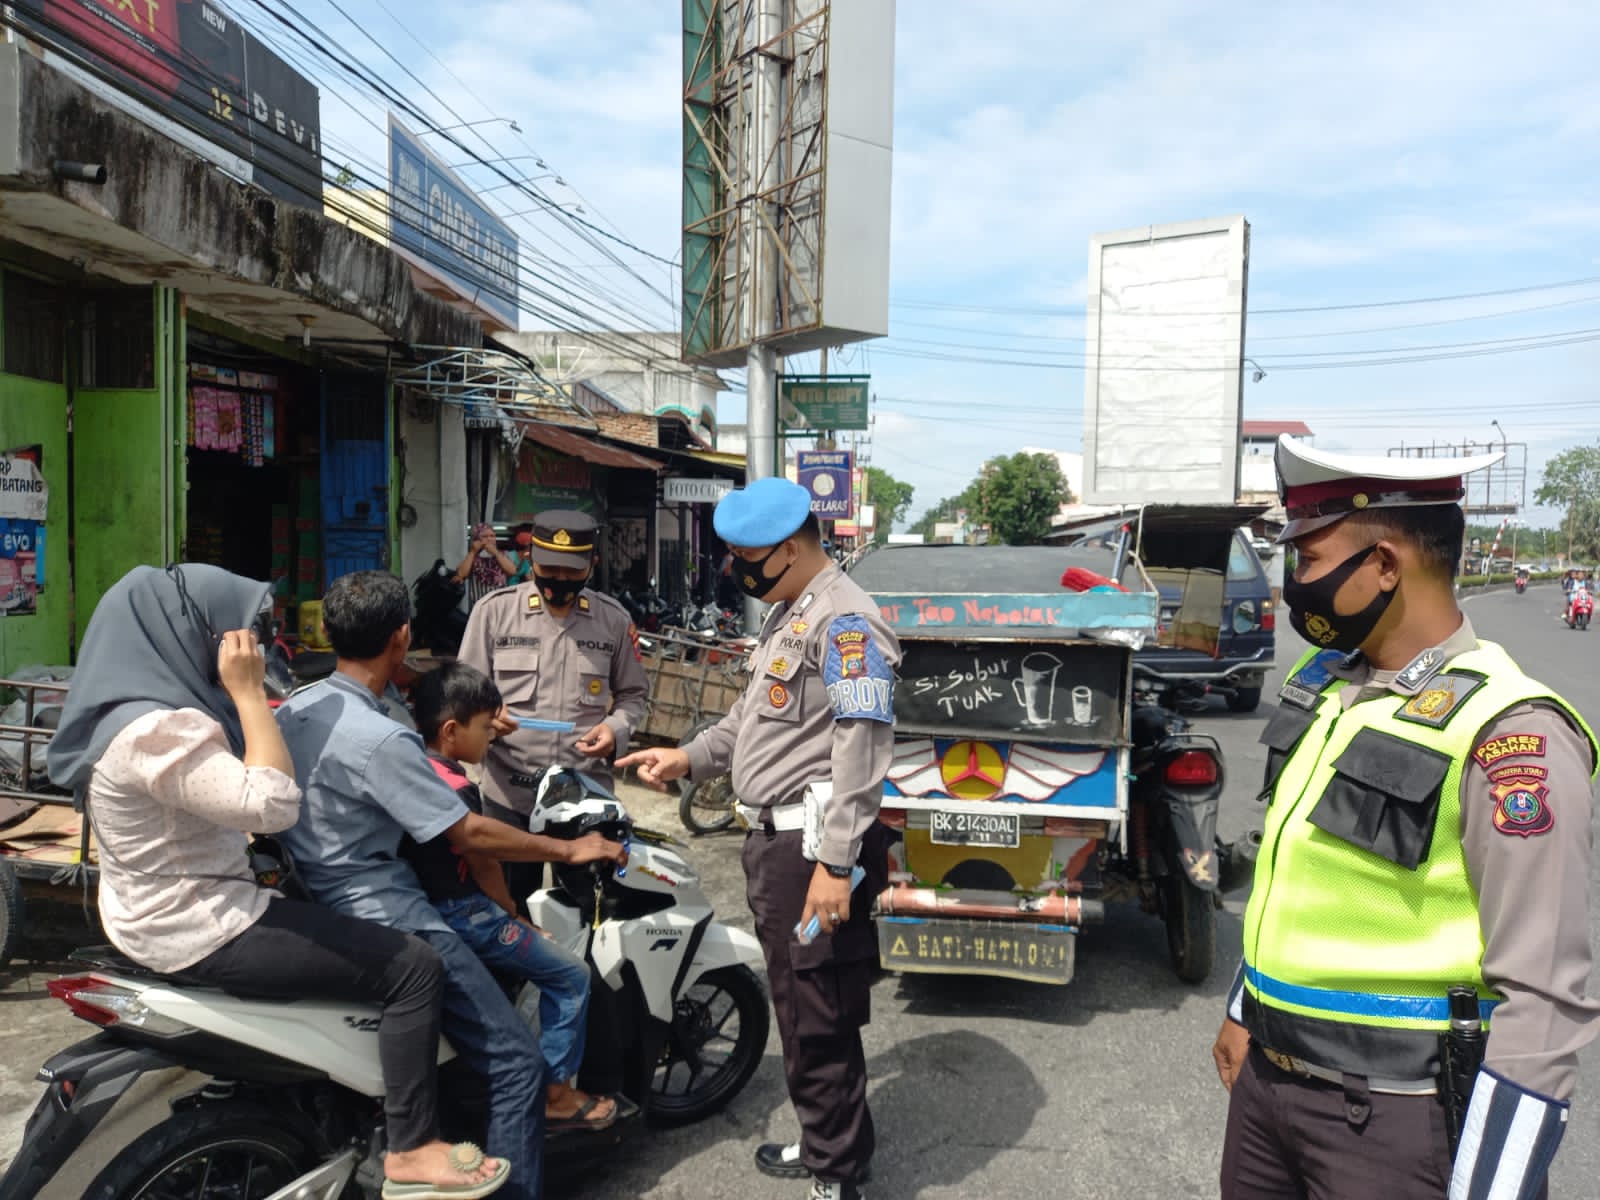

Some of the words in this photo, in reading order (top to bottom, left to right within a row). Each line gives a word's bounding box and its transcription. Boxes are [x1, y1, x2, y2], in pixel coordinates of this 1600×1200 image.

[201, 3, 227, 33] NEW
[669, 483, 698, 497] FOTO
[577, 639, 613, 652] POLRI
[826, 677, 892, 715] PROV
[1476, 735, 1540, 757] POLRES
[1485, 743, 1537, 762] ASAHAN
[934, 812, 952, 831] BK
[645, 928, 682, 936] HONDA
